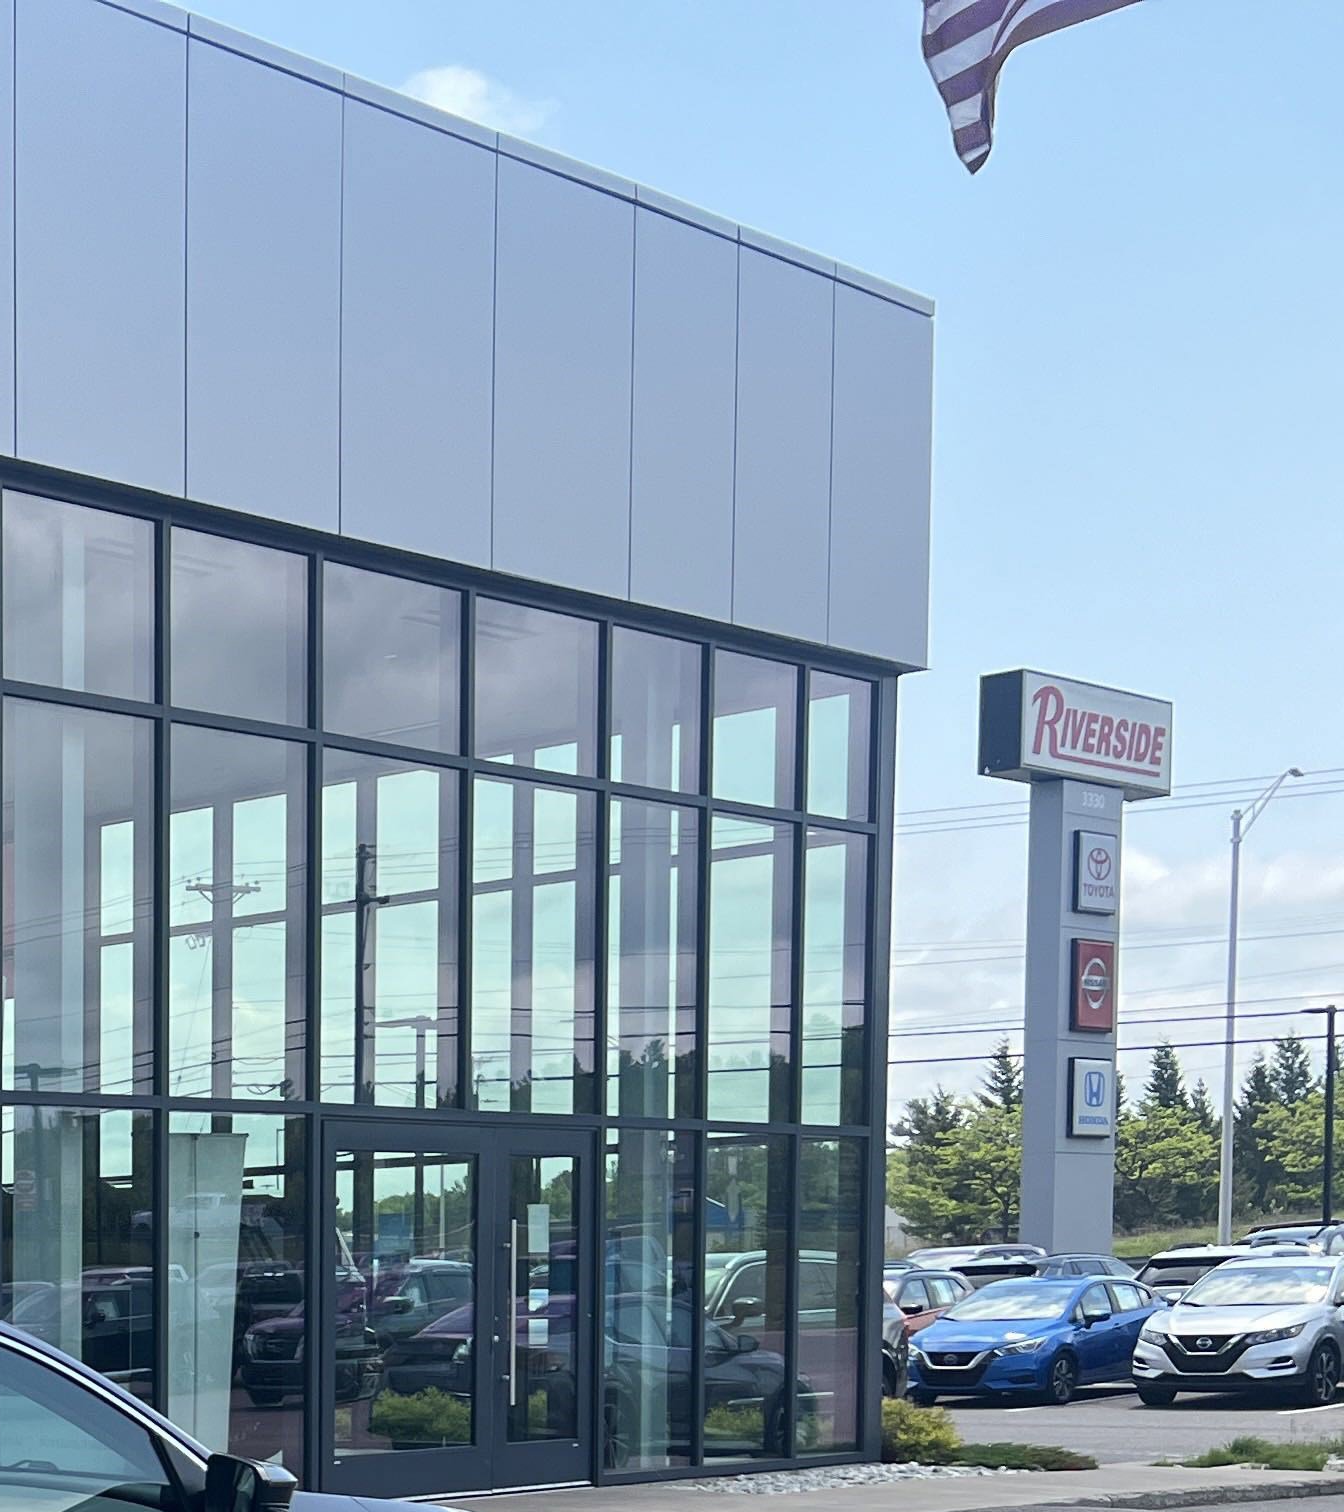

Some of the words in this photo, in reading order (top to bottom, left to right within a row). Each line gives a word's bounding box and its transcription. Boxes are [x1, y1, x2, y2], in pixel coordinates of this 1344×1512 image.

[1031, 685, 1167, 778] RIVERSIDE
[1081, 790, 1106, 809] 3330
[1082, 881, 1115, 899] TOYOTA
[1078, 1114, 1110, 1126] HONDA
